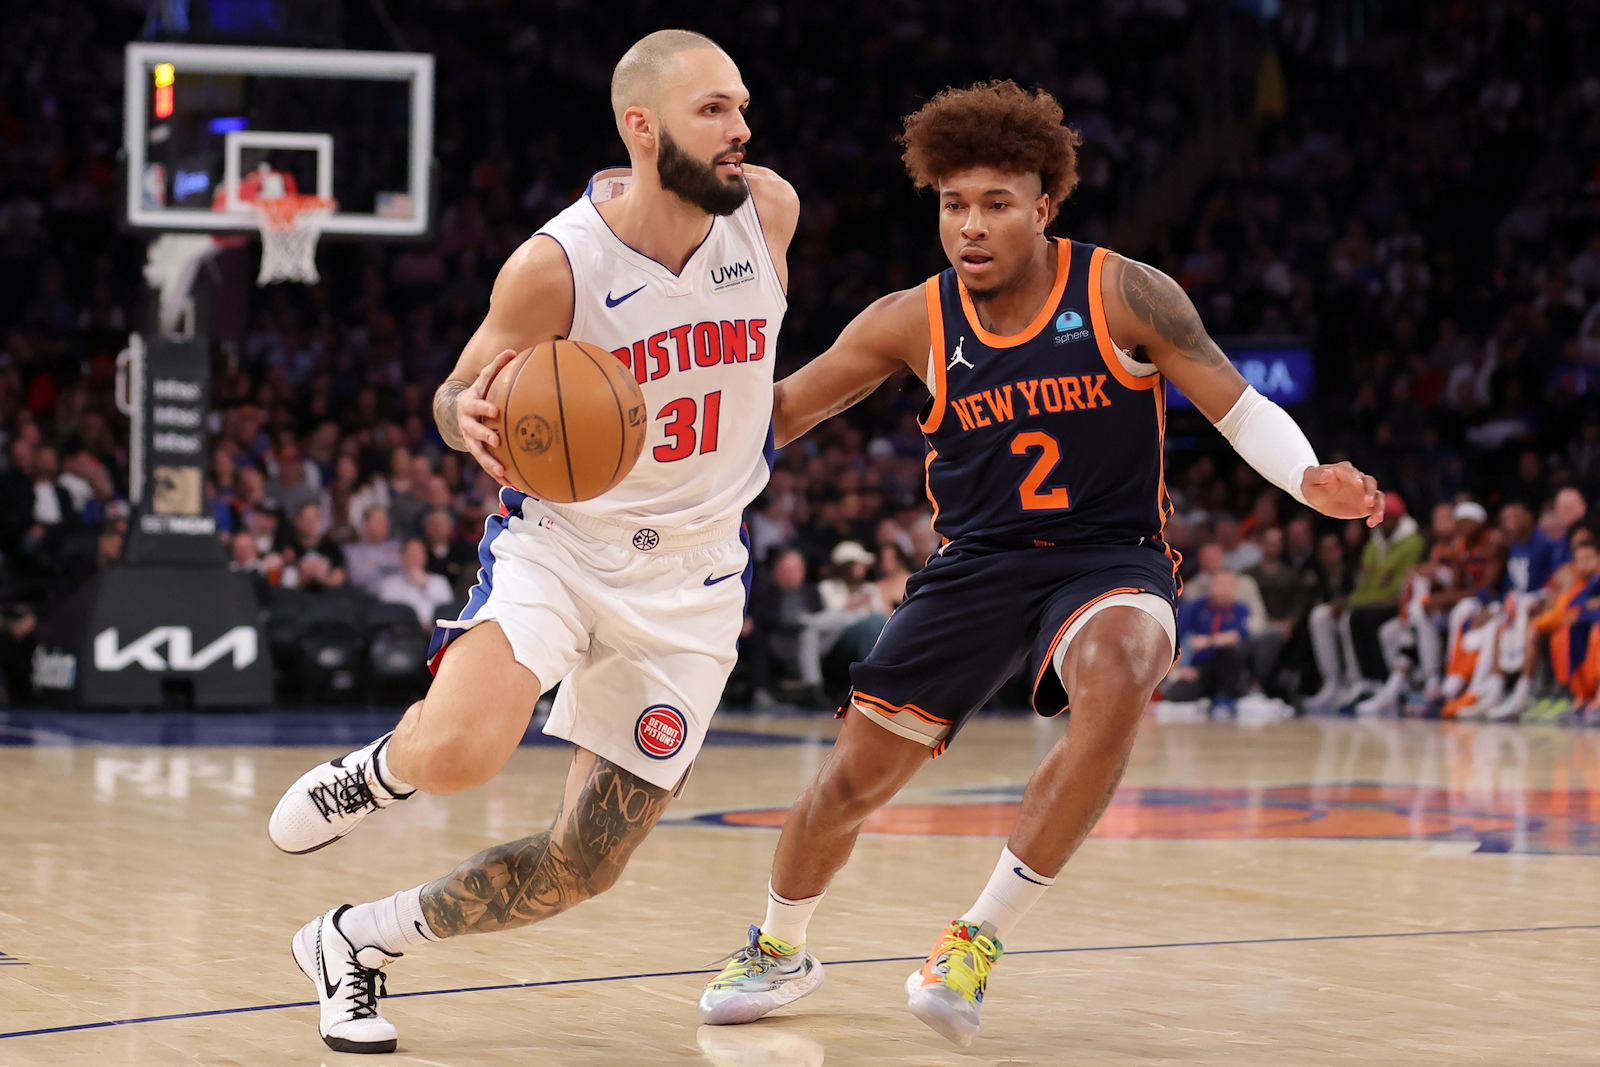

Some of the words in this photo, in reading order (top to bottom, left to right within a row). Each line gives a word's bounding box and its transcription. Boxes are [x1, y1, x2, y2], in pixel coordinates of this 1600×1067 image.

[710, 259, 754, 284] UWM
[1054, 329, 1090, 344] sphere
[950, 384, 1015, 432] NEW
[1016, 374, 1112, 416] YORK
[653, 390, 722, 463] 31
[1009, 429, 1072, 512] 2
[94, 625, 258, 671] KIA
[643, 724, 676, 747] PISTONS
[648, 716, 679, 739] DETROIT
[586, 761, 666, 829] KNOW
[589, 803, 617, 834] YOU
